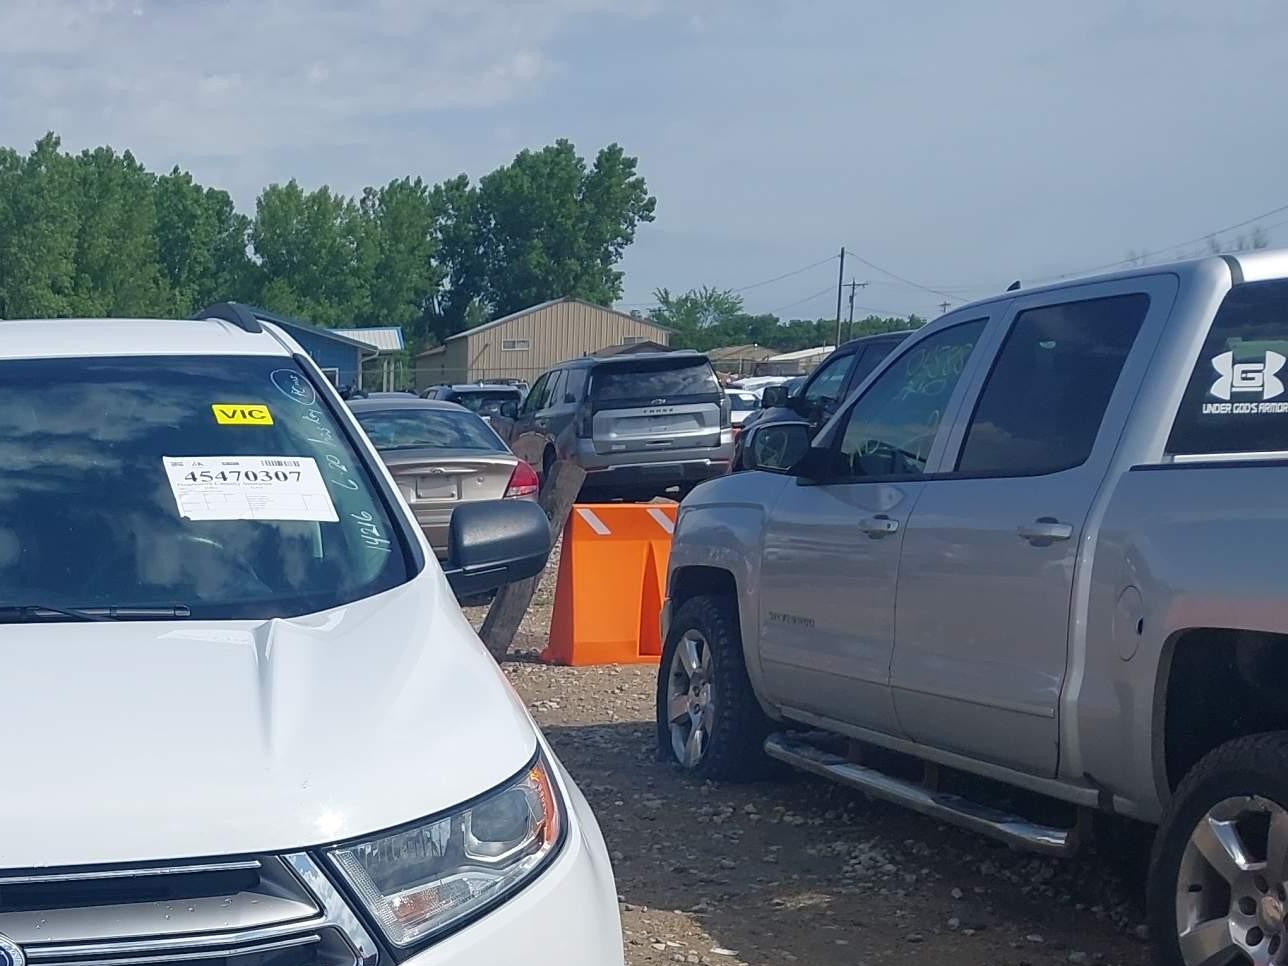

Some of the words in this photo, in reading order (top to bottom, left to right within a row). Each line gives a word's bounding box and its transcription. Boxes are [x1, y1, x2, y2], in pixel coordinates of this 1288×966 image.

[1202, 403, 1232, 414] UNDER
[218, 409, 266, 420] VIC
[184, 470, 302, 483] 45470307
